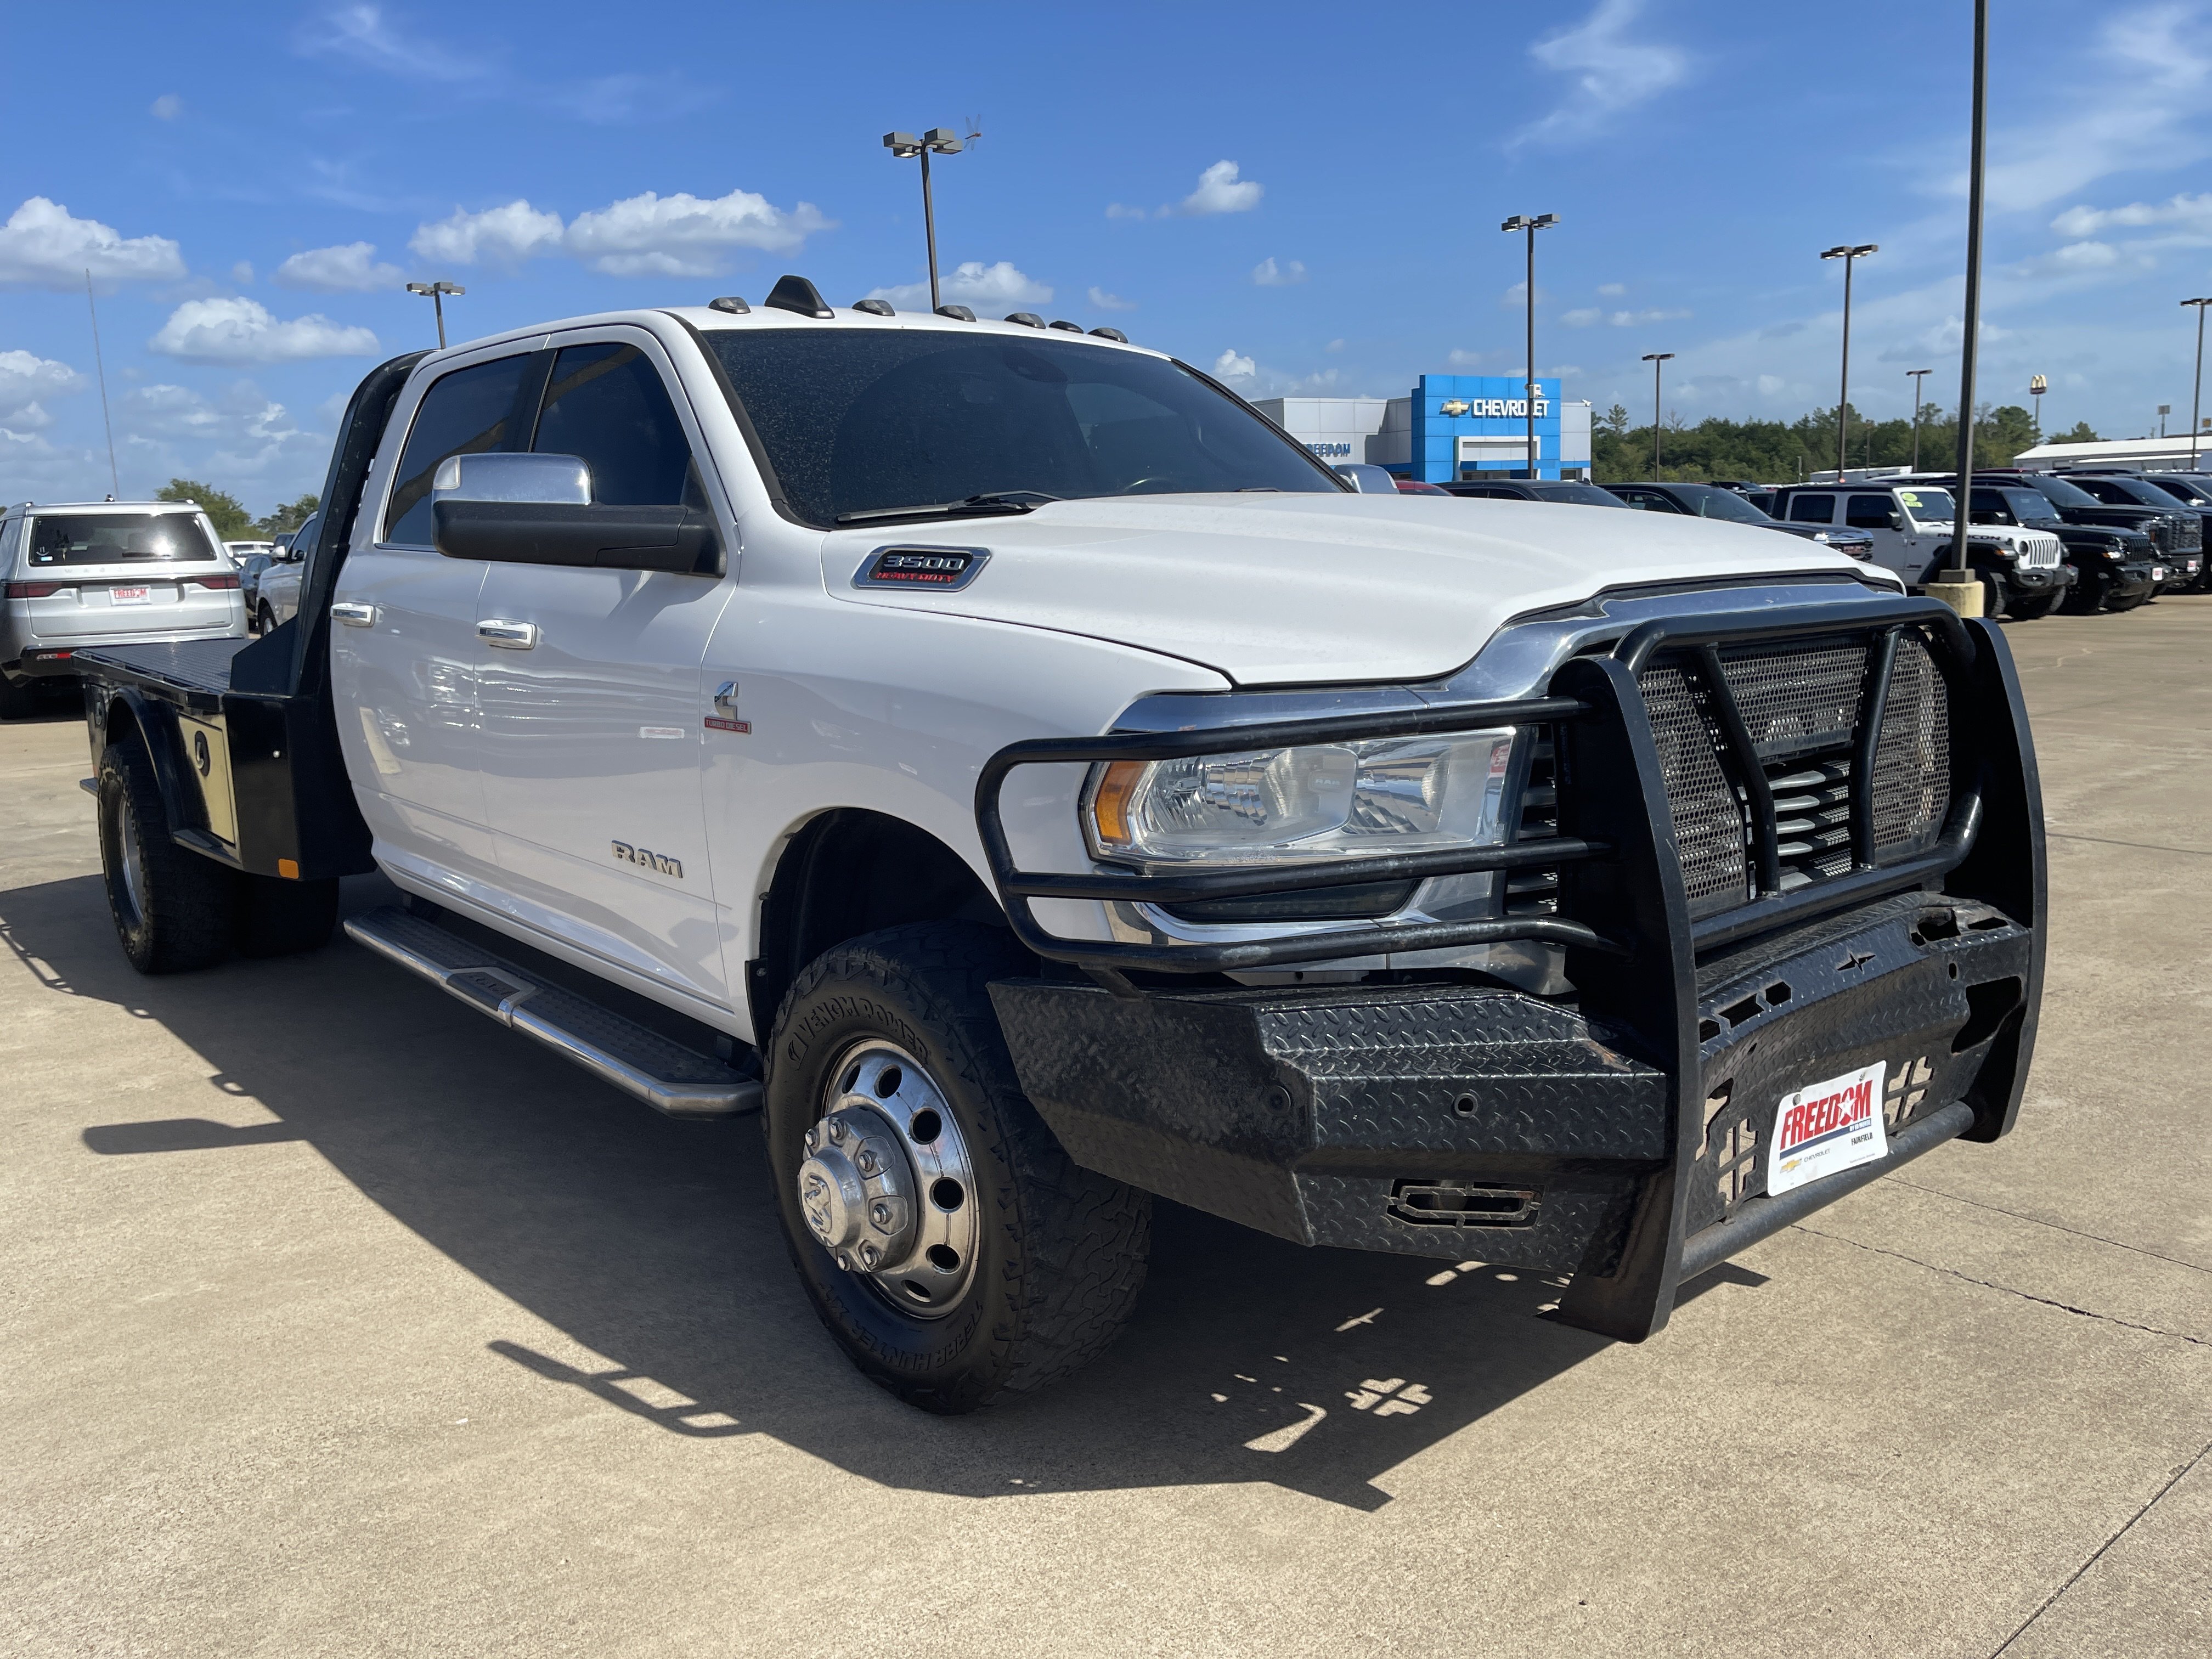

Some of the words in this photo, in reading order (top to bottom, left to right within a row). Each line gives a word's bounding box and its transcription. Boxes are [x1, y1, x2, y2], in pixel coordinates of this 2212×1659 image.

[1473, 399, 1550, 416] CHEVROET
[1302, 443, 1351, 454] REEDOM
[884, 555, 964, 570] 3500
[875, 572, 916, 580] HEAVY
[918, 573, 954, 582] DUTY
[705, 719, 725, 729] TURBO
[725, 720, 748, 732] DIESEL
[611, 839, 684, 878] RAM
[798, 996, 861, 1040] VENOM
[859, 997, 929, 1065] POWER
[1780, 1080, 1872, 1150] FREEDOM
[1851, 1132, 1873, 1146] FAIRFIELD
[1804, 1148, 1831, 1163] CHEVROLET
